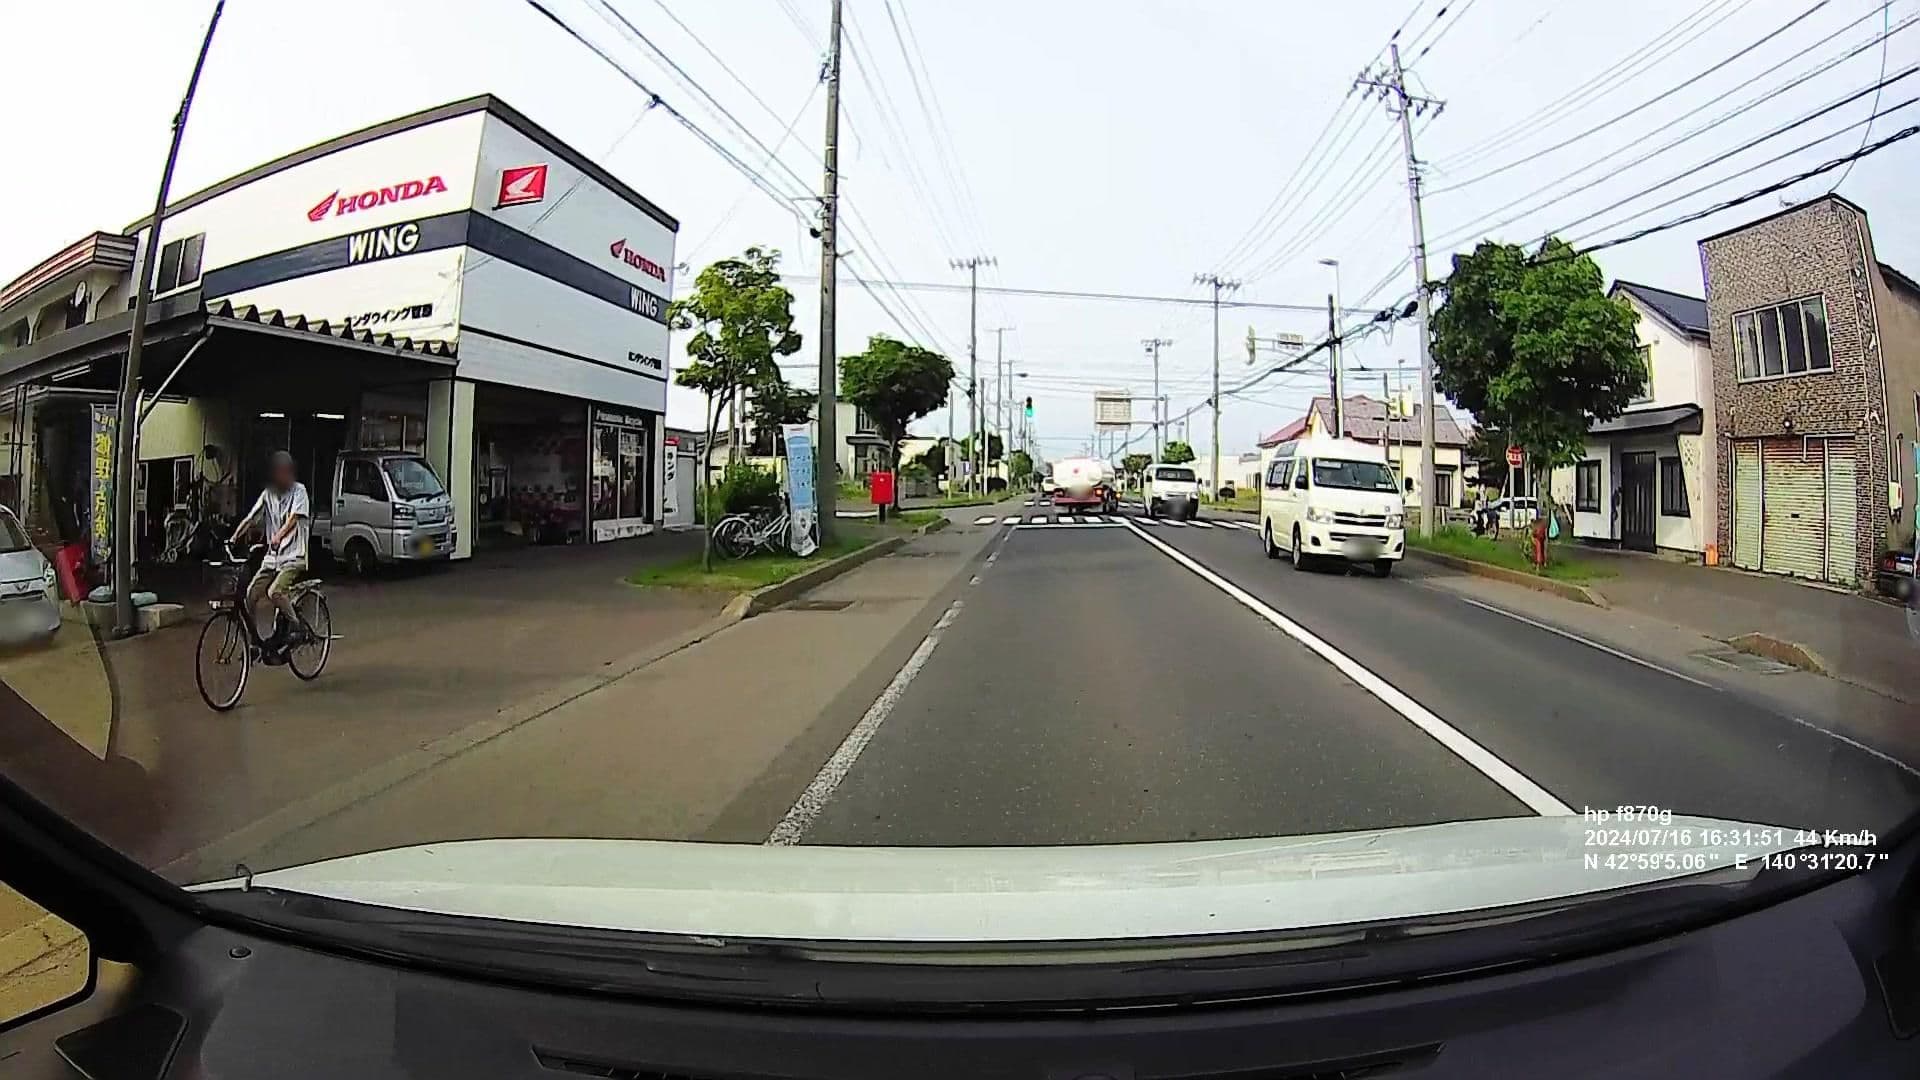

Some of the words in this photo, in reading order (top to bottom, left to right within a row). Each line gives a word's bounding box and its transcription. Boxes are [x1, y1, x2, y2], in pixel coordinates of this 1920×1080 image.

[336, 175, 447, 216] HONDA
[348, 222, 419, 265] WING
[624, 248, 666, 282] HONDA
[631, 287, 658, 318] WING
